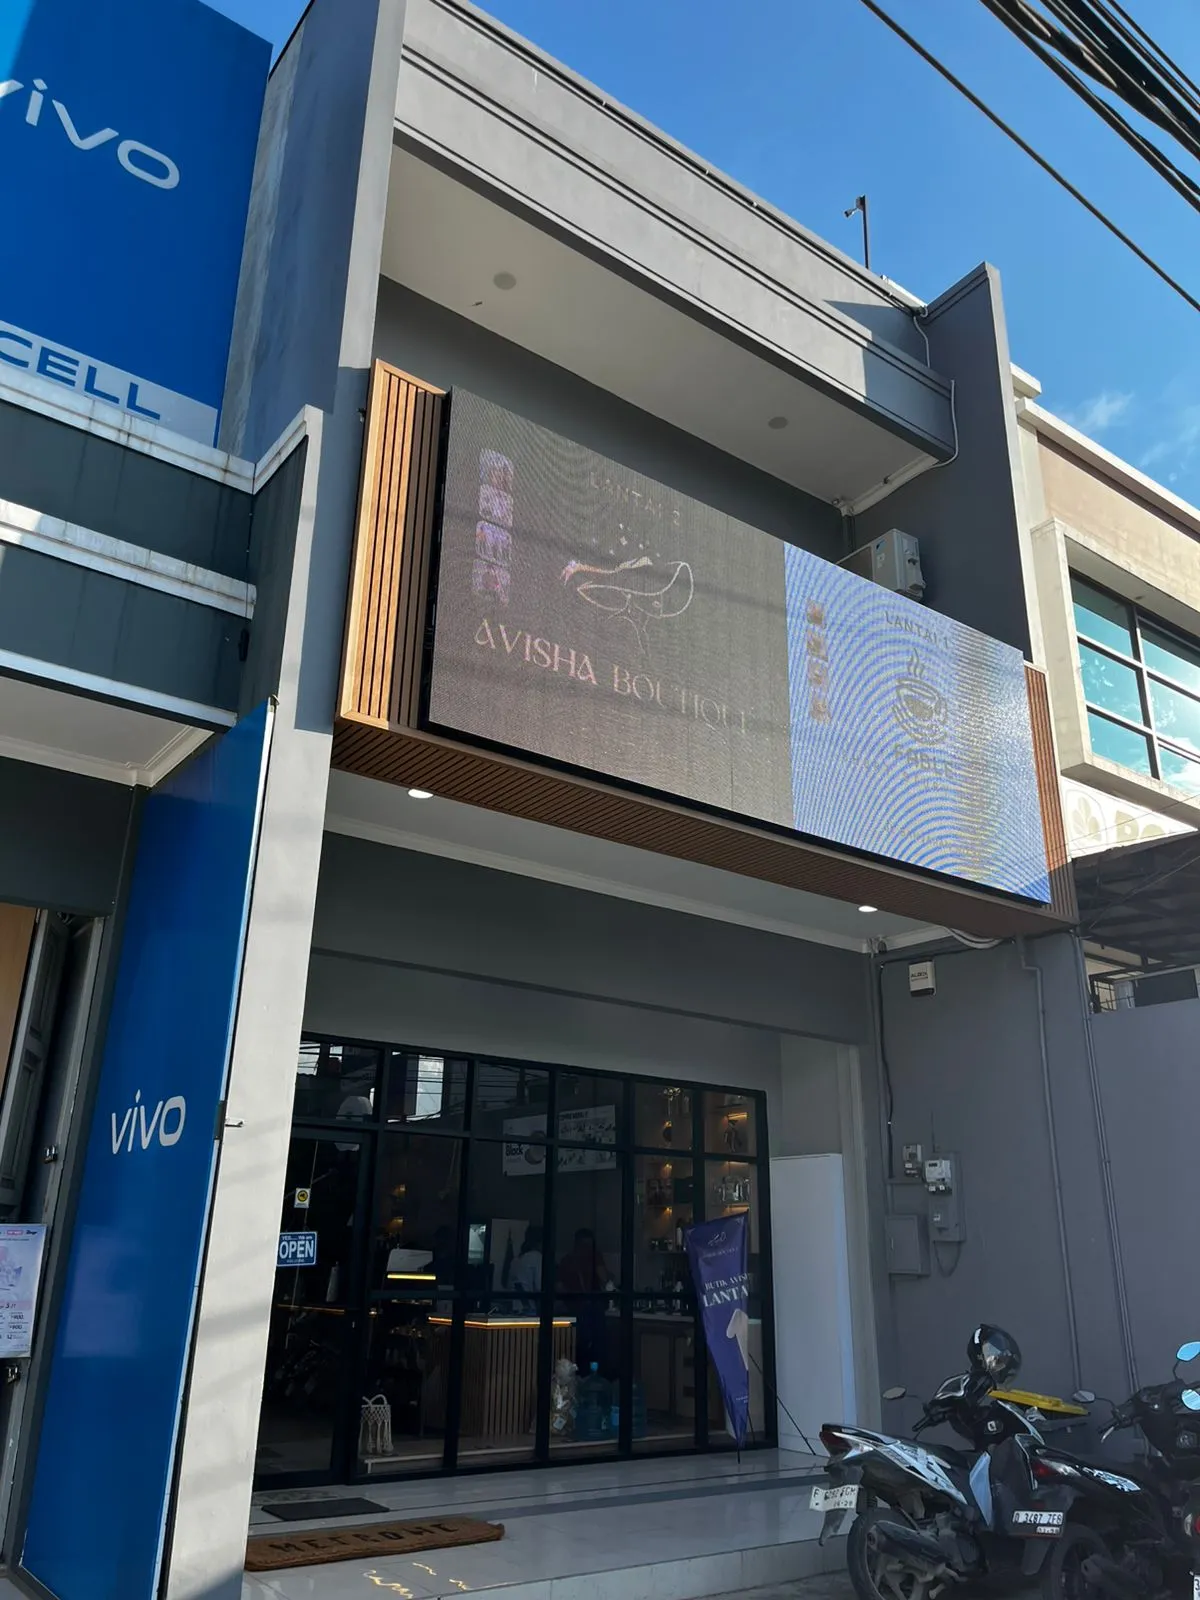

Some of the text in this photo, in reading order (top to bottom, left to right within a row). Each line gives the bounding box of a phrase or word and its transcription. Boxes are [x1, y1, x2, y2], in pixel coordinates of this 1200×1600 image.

[0, 330, 161, 420] CELL
[474, 617, 599, 686] AVISHA
[111, 1089, 186, 1155] vivo
[279, 1240, 315, 1259] OPEN
